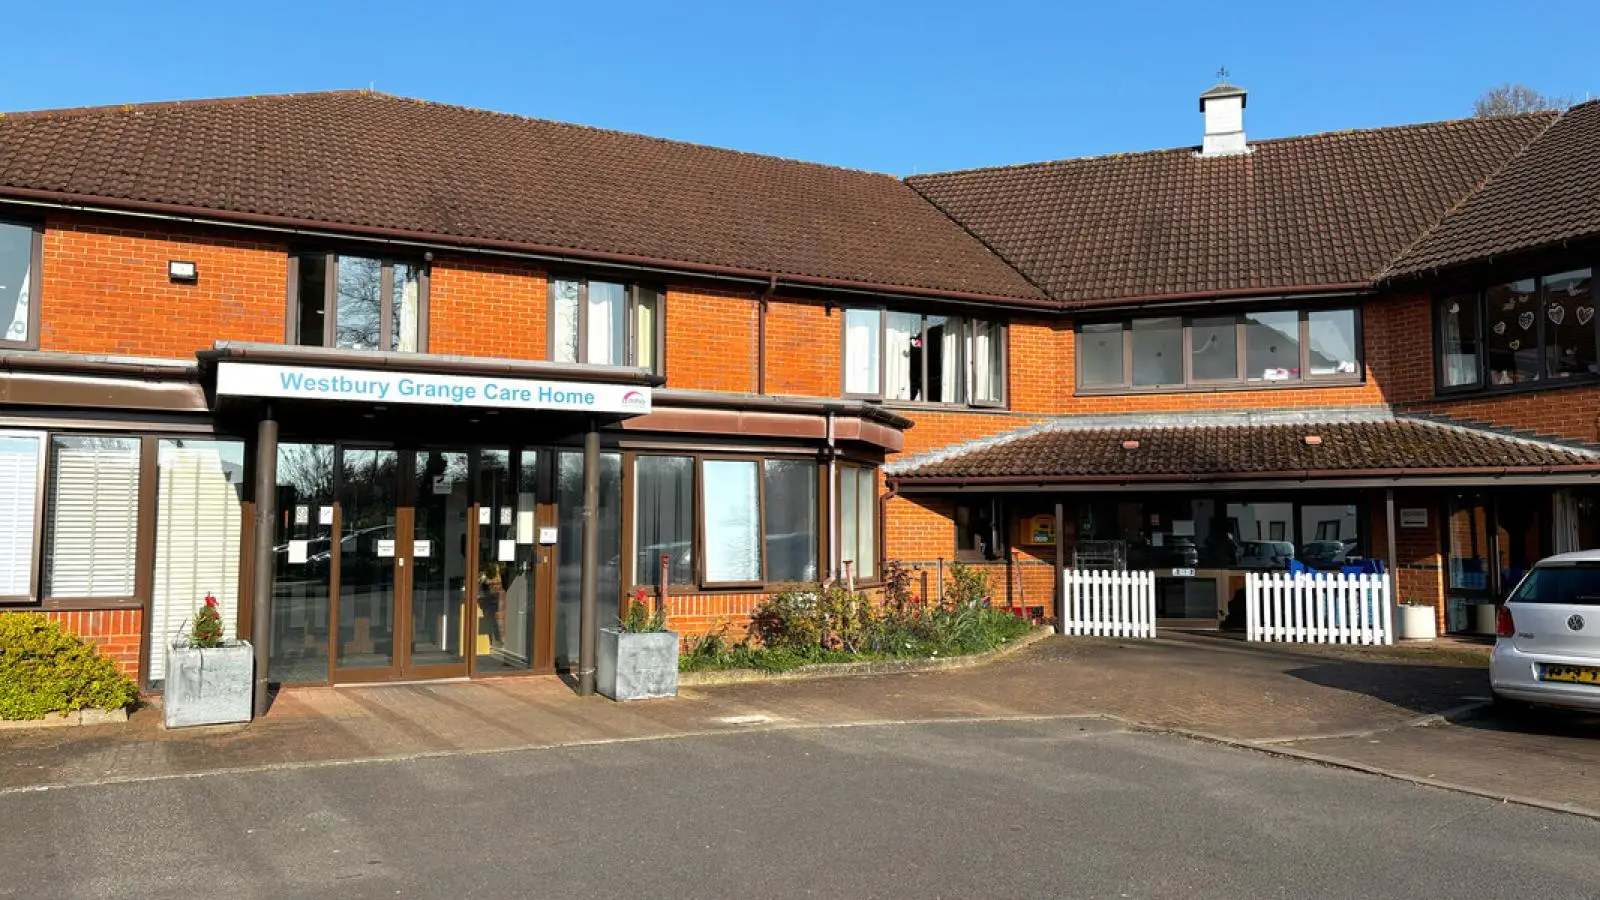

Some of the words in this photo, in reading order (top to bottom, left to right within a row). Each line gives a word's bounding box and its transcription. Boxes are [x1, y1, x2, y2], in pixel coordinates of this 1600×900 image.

[280, 372, 391, 399] Westbury
[398, 379, 477, 403] Grange
[483, 383, 532, 402] Care
[538, 386, 596, 405] Home
